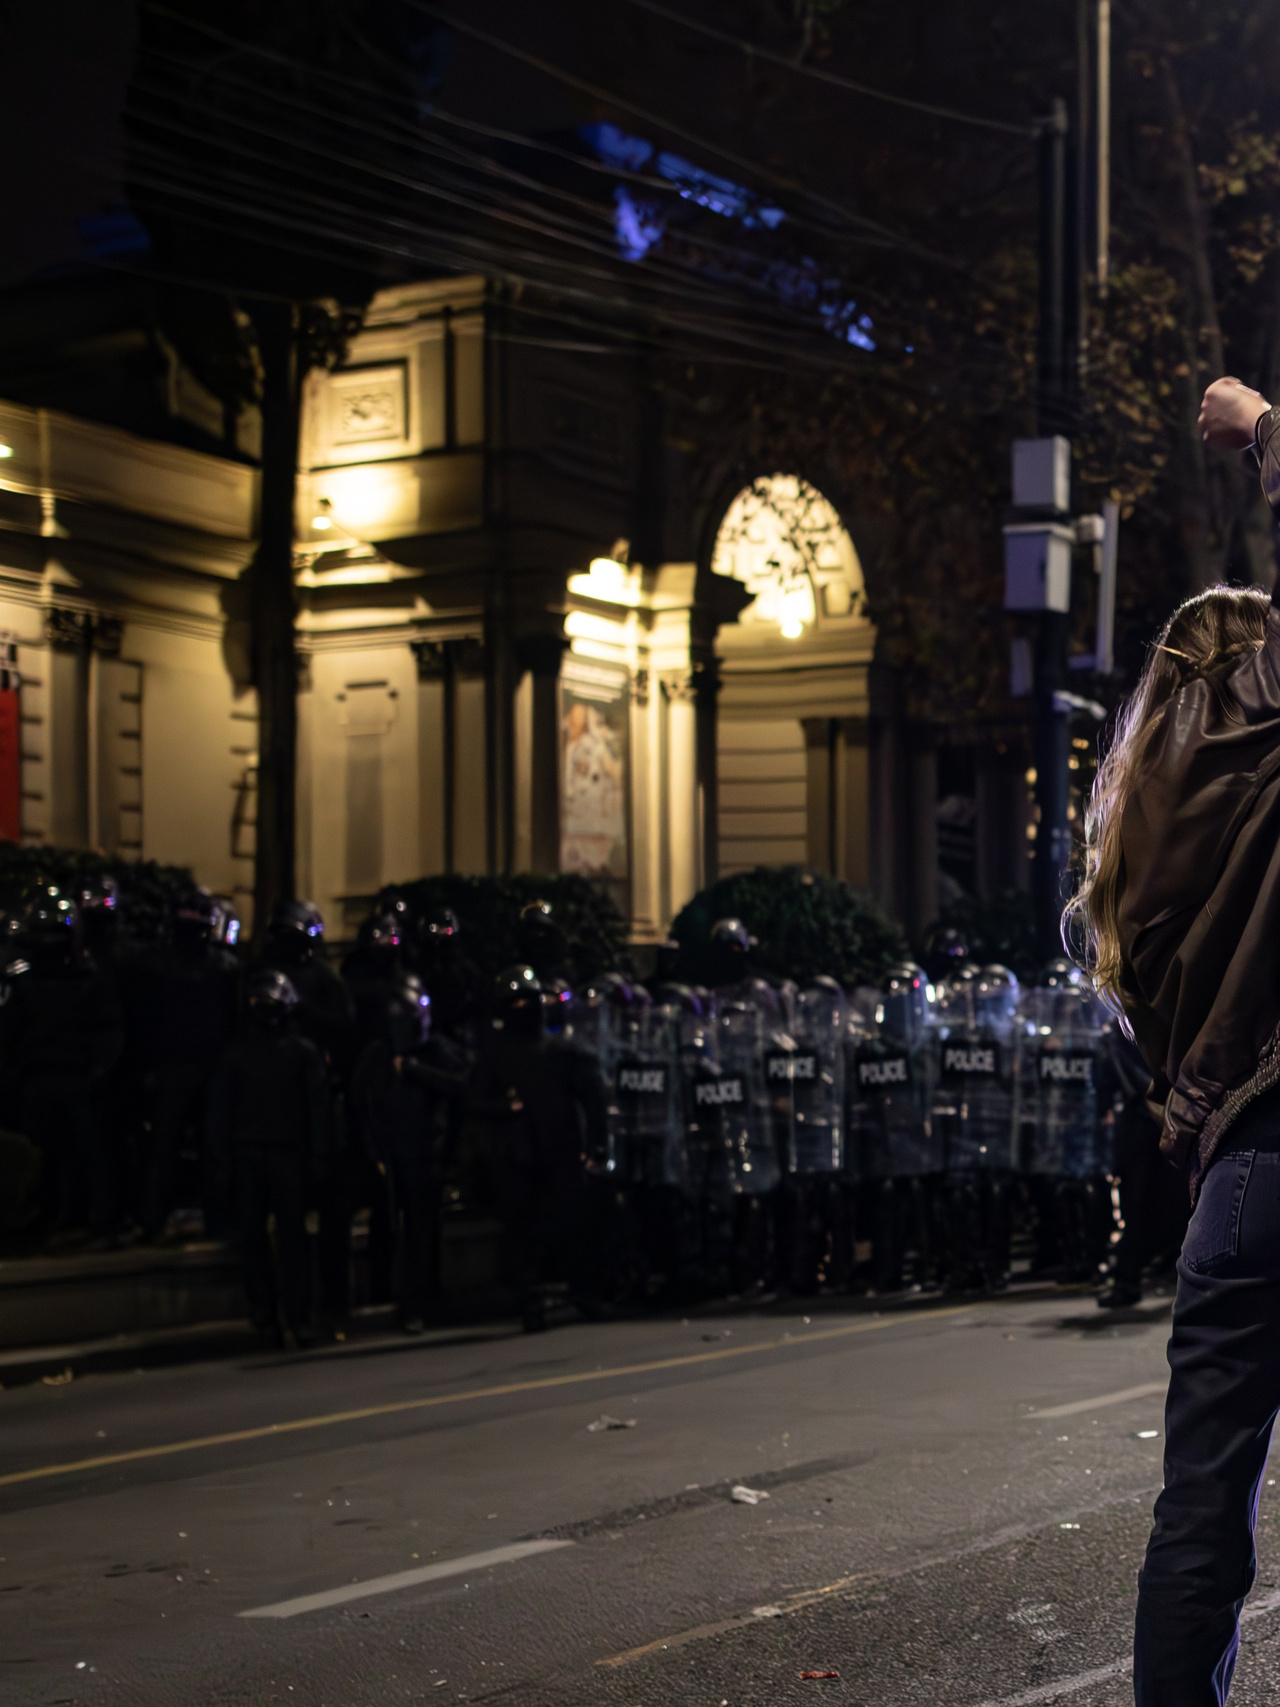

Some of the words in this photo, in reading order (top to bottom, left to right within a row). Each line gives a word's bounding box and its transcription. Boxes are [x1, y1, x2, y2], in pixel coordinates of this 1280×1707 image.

[768, 1056, 816, 1080] POLICE
[858, 1057, 908, 1085] POLICE
[945, 1049, 995, 1073] POLICE
[1040, 1056, 1093, 1080] POLICE
[619, 1069, 665, 1093] POLICE
[695, 1079, 743, 1105] POLICE
